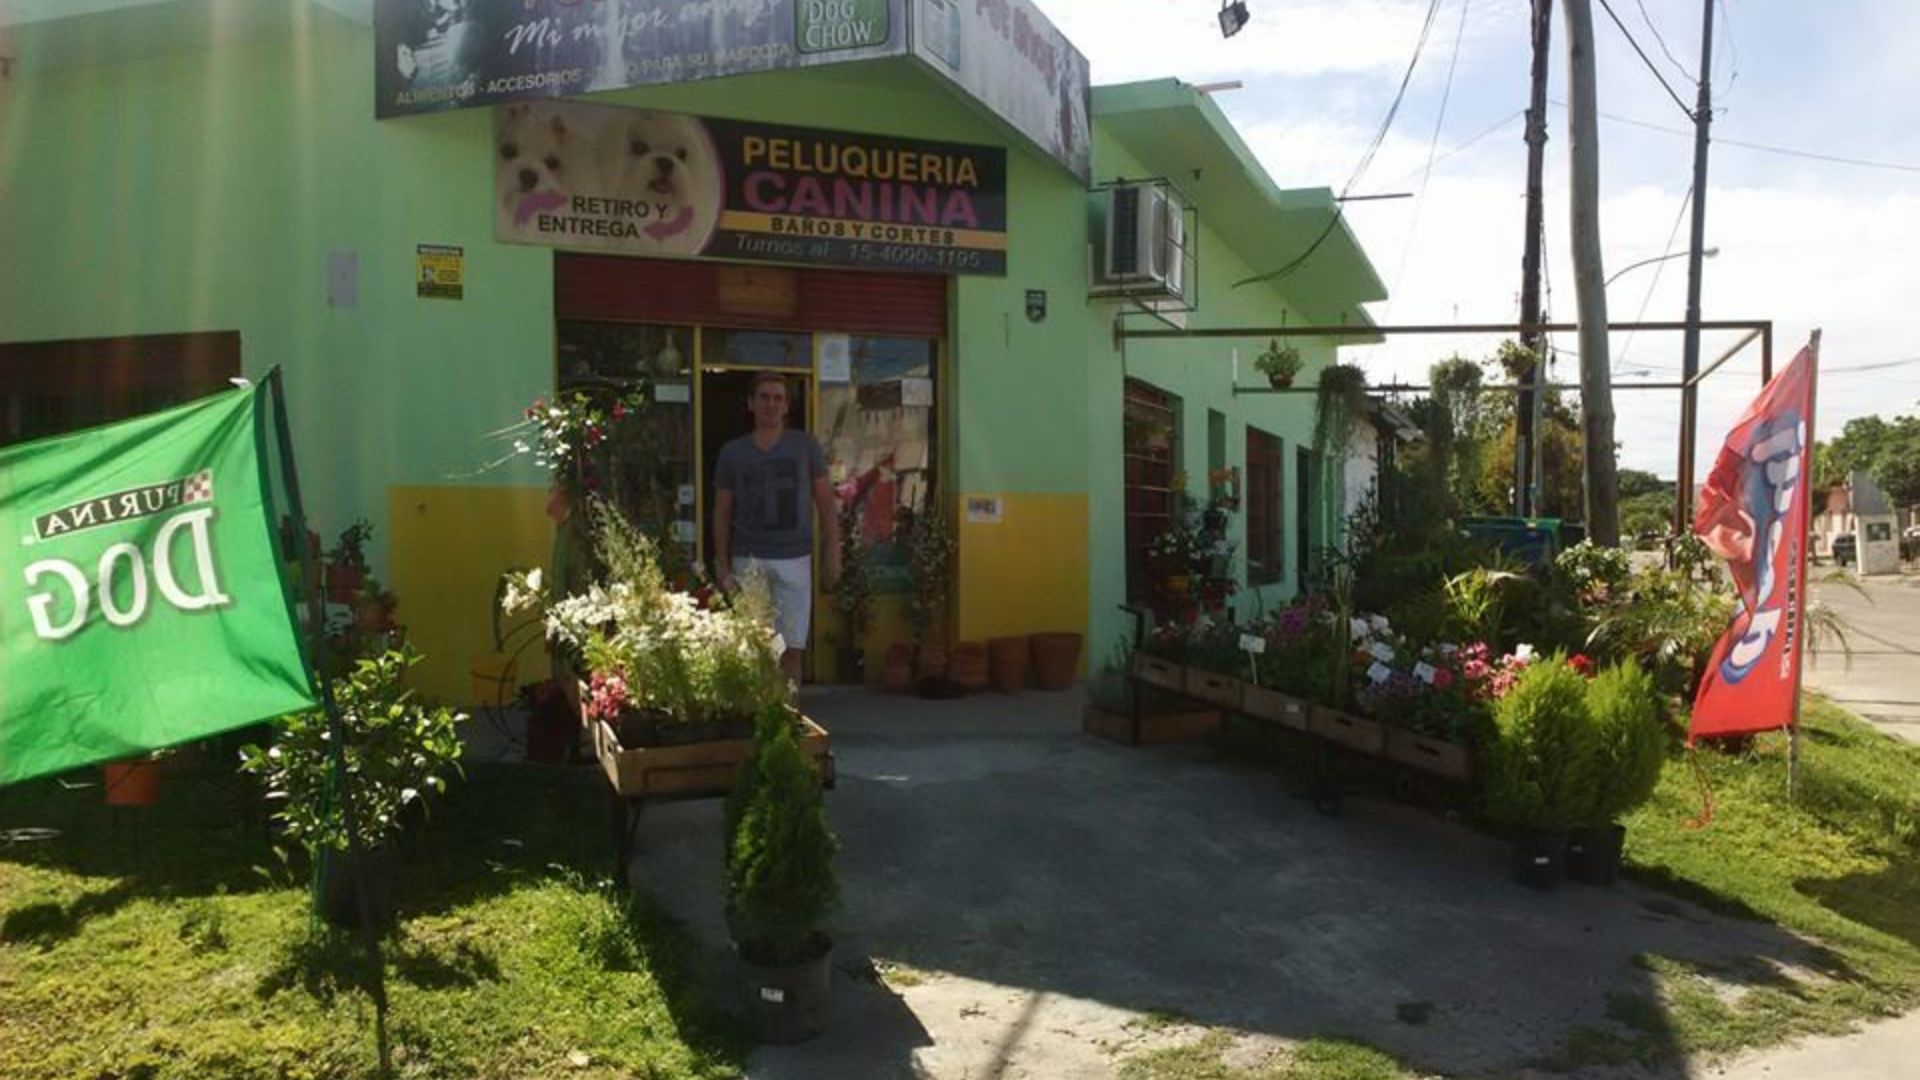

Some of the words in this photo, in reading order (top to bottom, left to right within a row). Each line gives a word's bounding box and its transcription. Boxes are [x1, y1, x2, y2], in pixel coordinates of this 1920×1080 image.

[808, 0, 855, 24] DOG
[504, 17, 562, 54] Mi
[573, 4, 669, 42] mjor
[806, 19, 873, 48] CHOW
[487, 69, 582, 94] ACCESORIOS
[742, 136, 978, 188] PELUQUERIA
[572, 196, 650, 219] RETIRO
[655, 203, 669, 220] Y
[743, 171, 979, 228] CANINA
[538, 215, 641, 239] ENTREGA
[770, 216, 847, 237] BAÑOS
[852, 223, 865, 238] Y
[870, 225, 956, 245] CORTES
